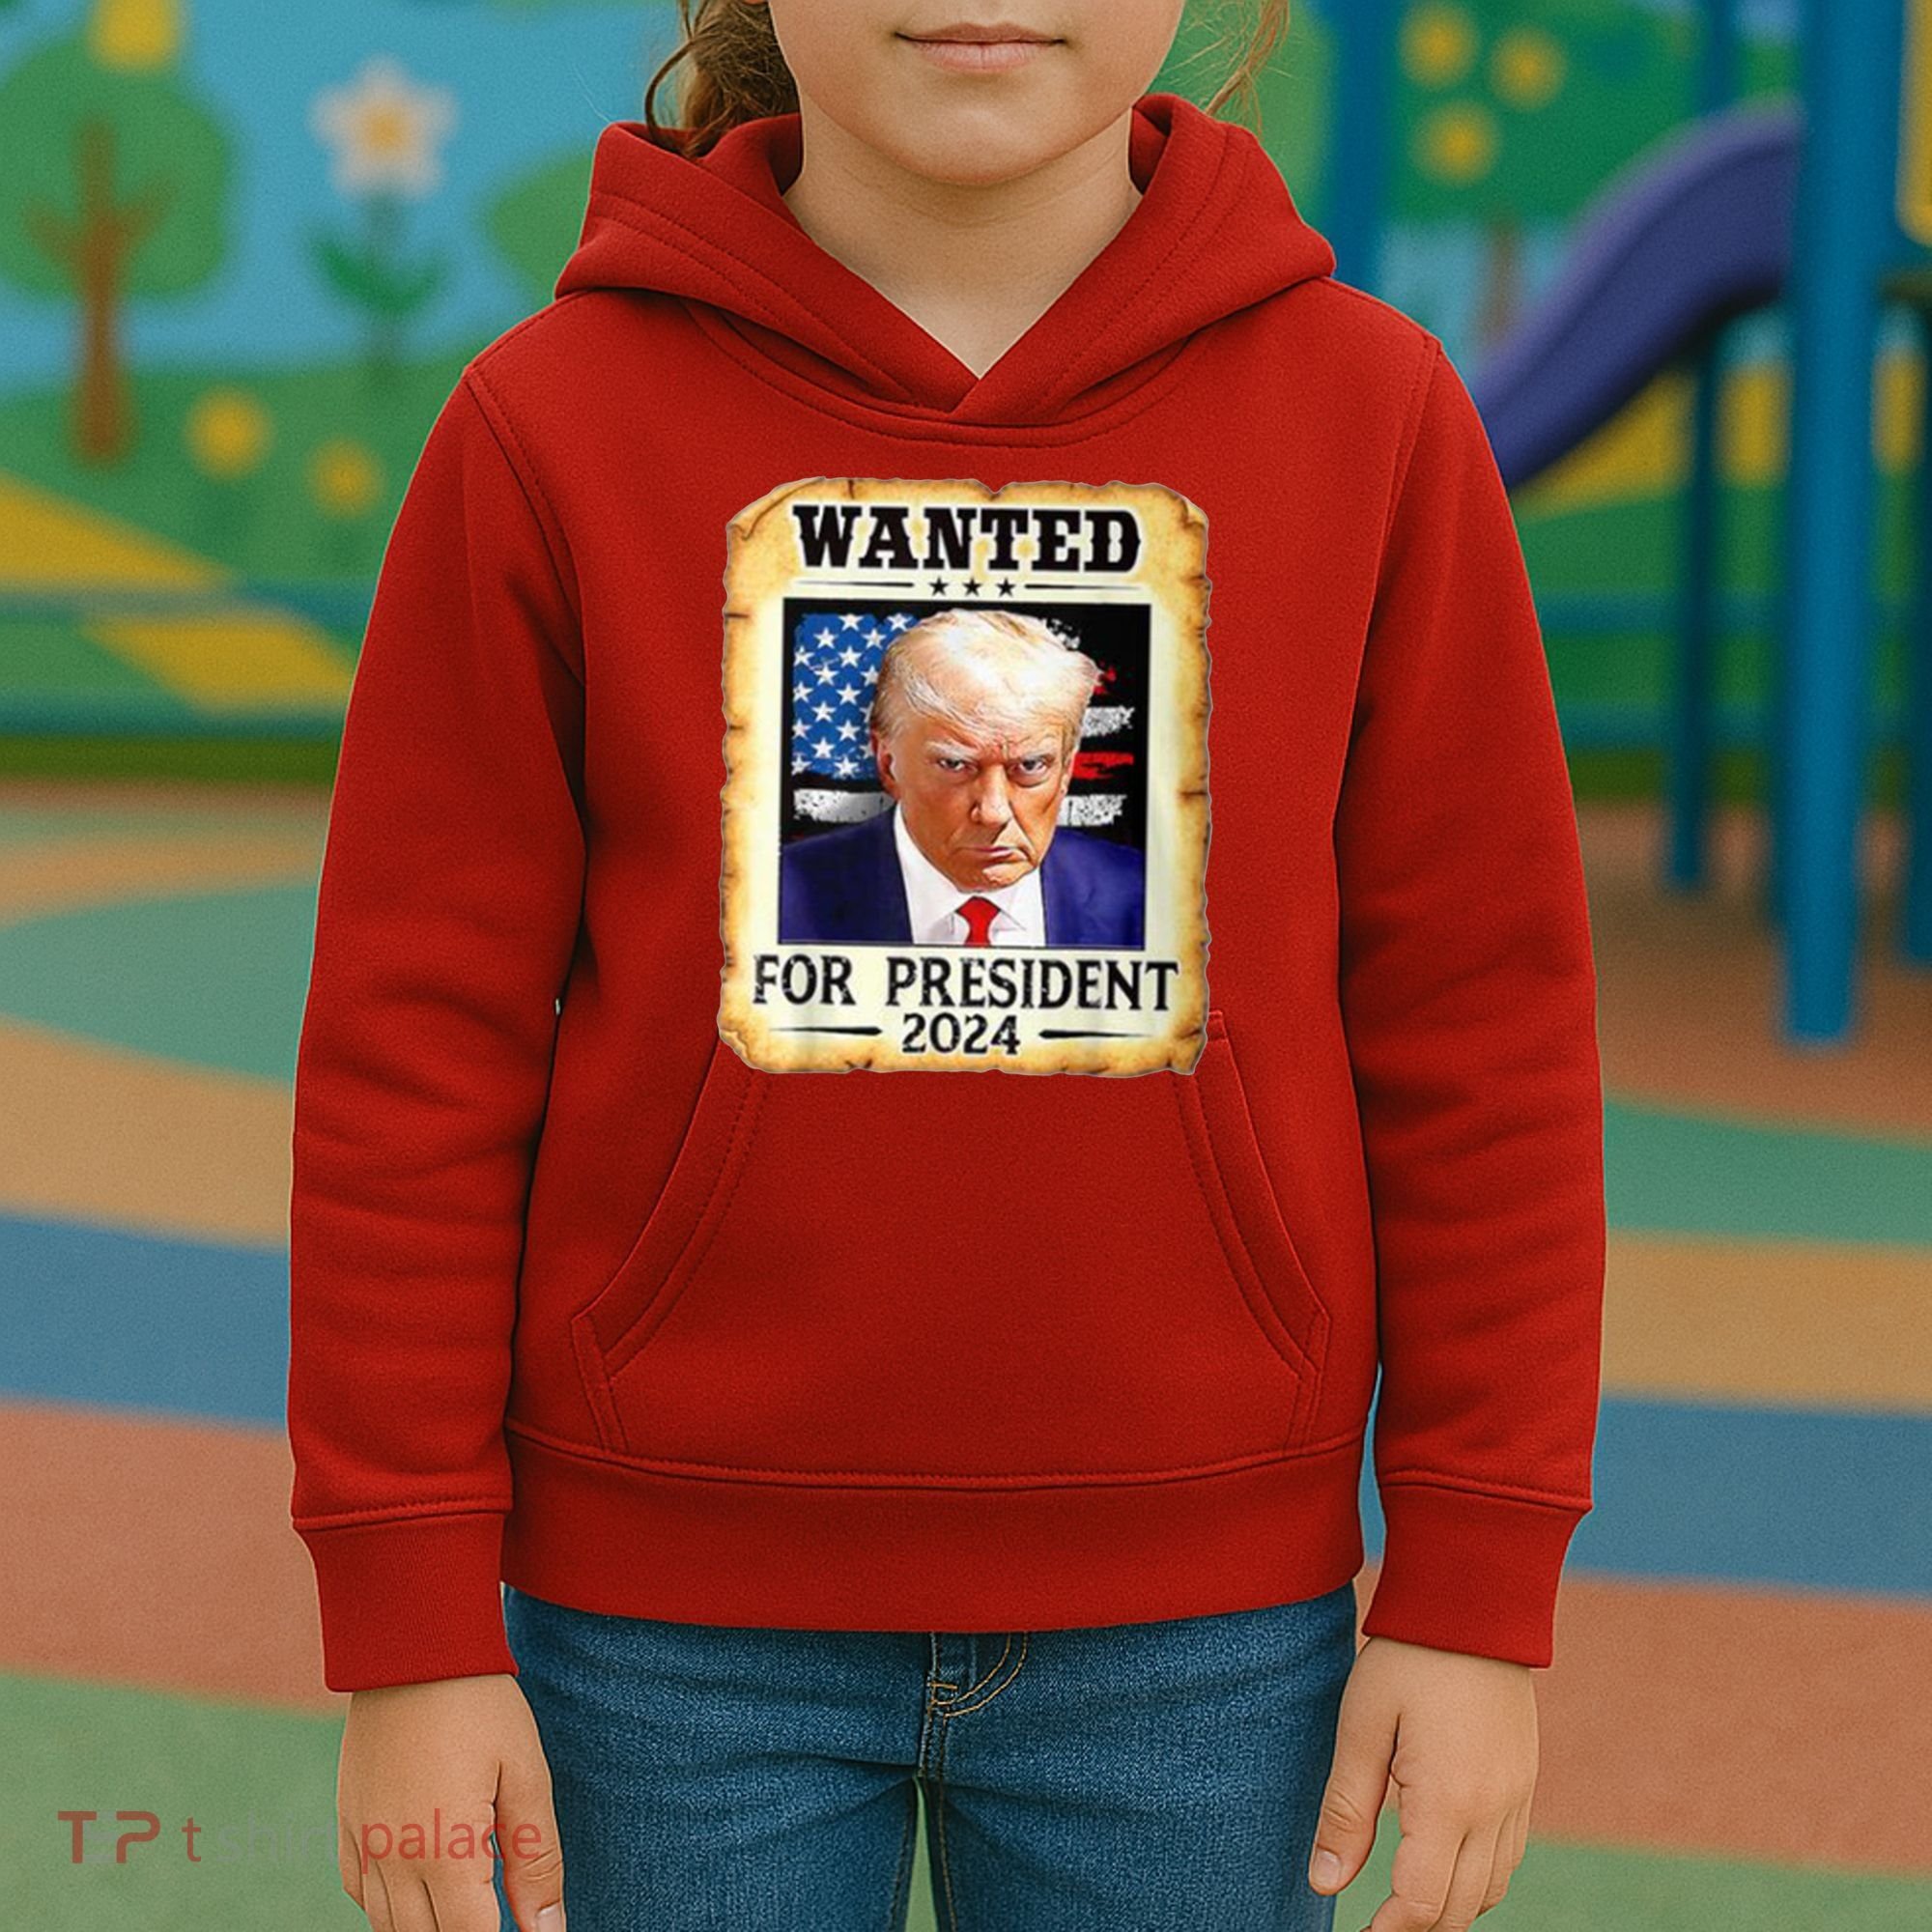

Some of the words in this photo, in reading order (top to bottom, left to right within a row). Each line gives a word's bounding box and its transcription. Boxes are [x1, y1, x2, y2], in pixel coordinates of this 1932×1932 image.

[792, 504, 1142, 573] WANTED
[753, 953, 857, 1006] FOR
[885, 955, 1179, 1010] PRESIDENT
[902, 1012, 1021, 1056] 2024
